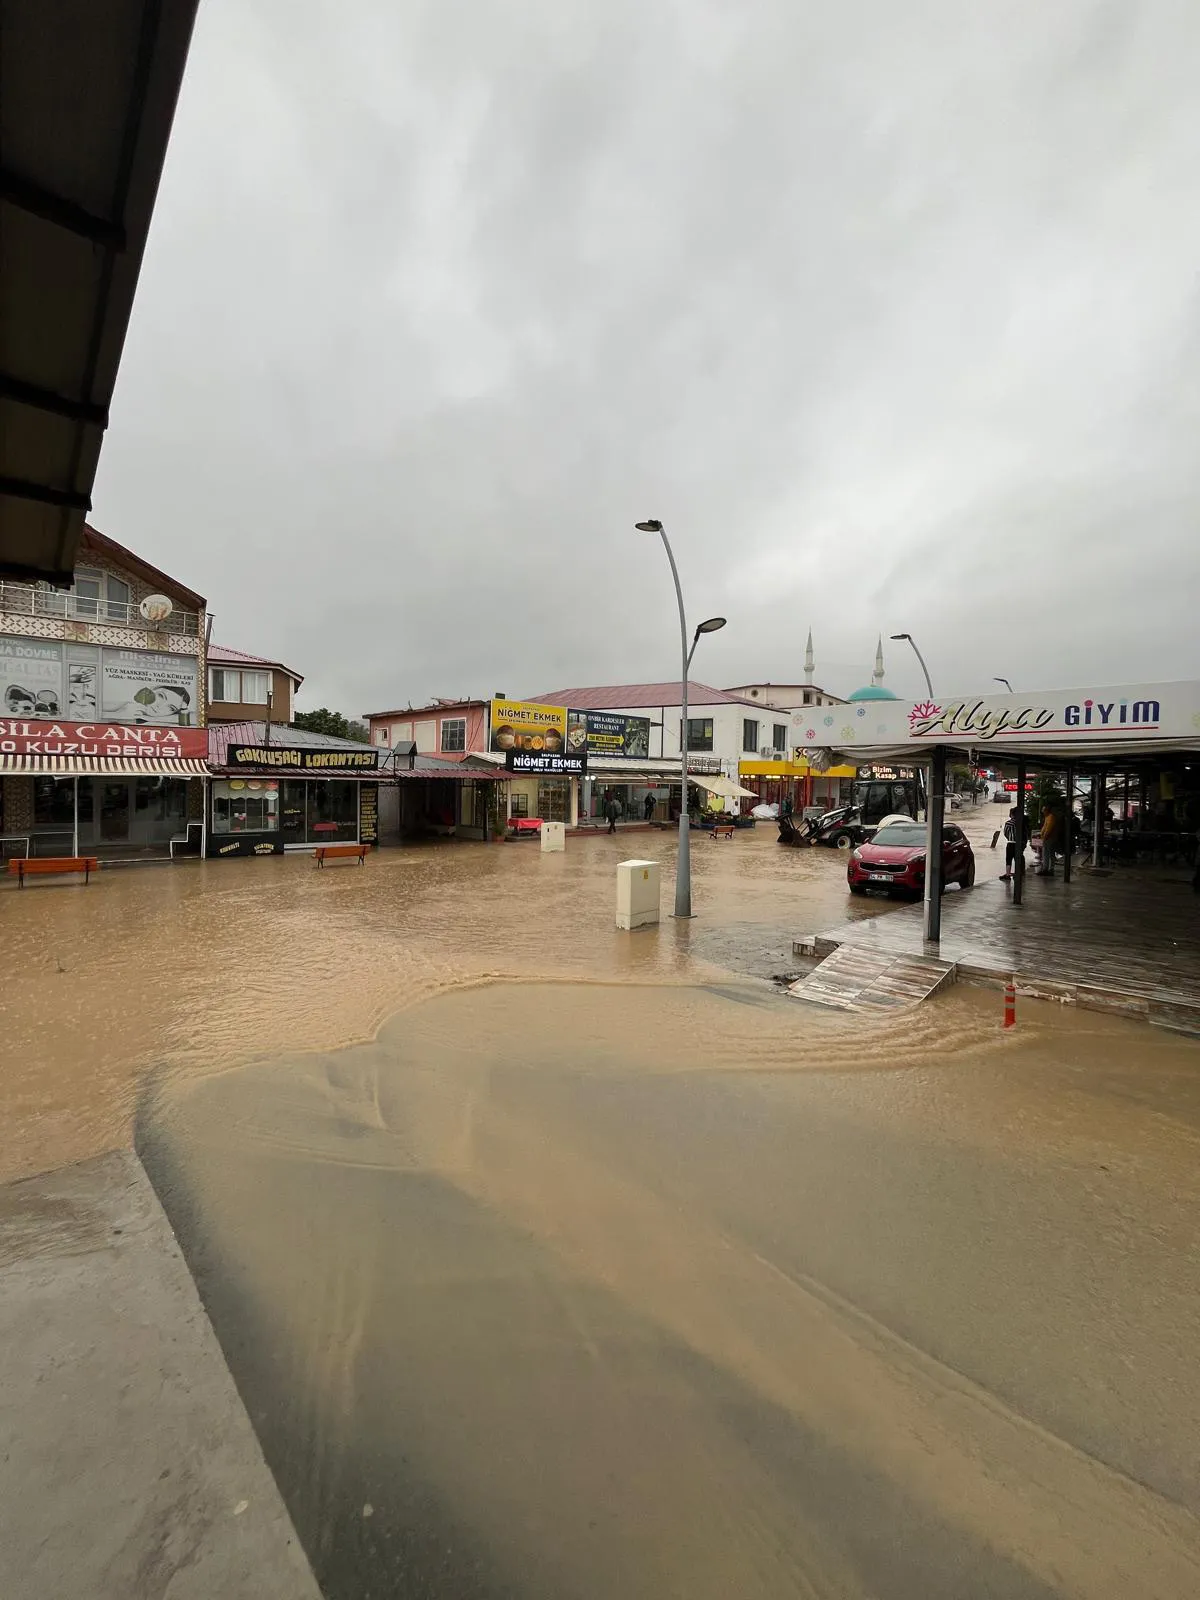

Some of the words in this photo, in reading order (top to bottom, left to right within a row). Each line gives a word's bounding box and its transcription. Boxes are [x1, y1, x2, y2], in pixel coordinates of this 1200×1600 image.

[533, 713, 562, 722] EKMEK
[910, 699, 1054, 739] Alya
[26, 741, 98, 754] KUZU
[106, 743, 182, 757] DERİSİ
[305, 753, 376, 768] LOKANTASI
[513, 754, 550, 767] NİĞMET
[551, 759, 582, 768] EKMEK
[875, 772, 897, 780] Kasap
